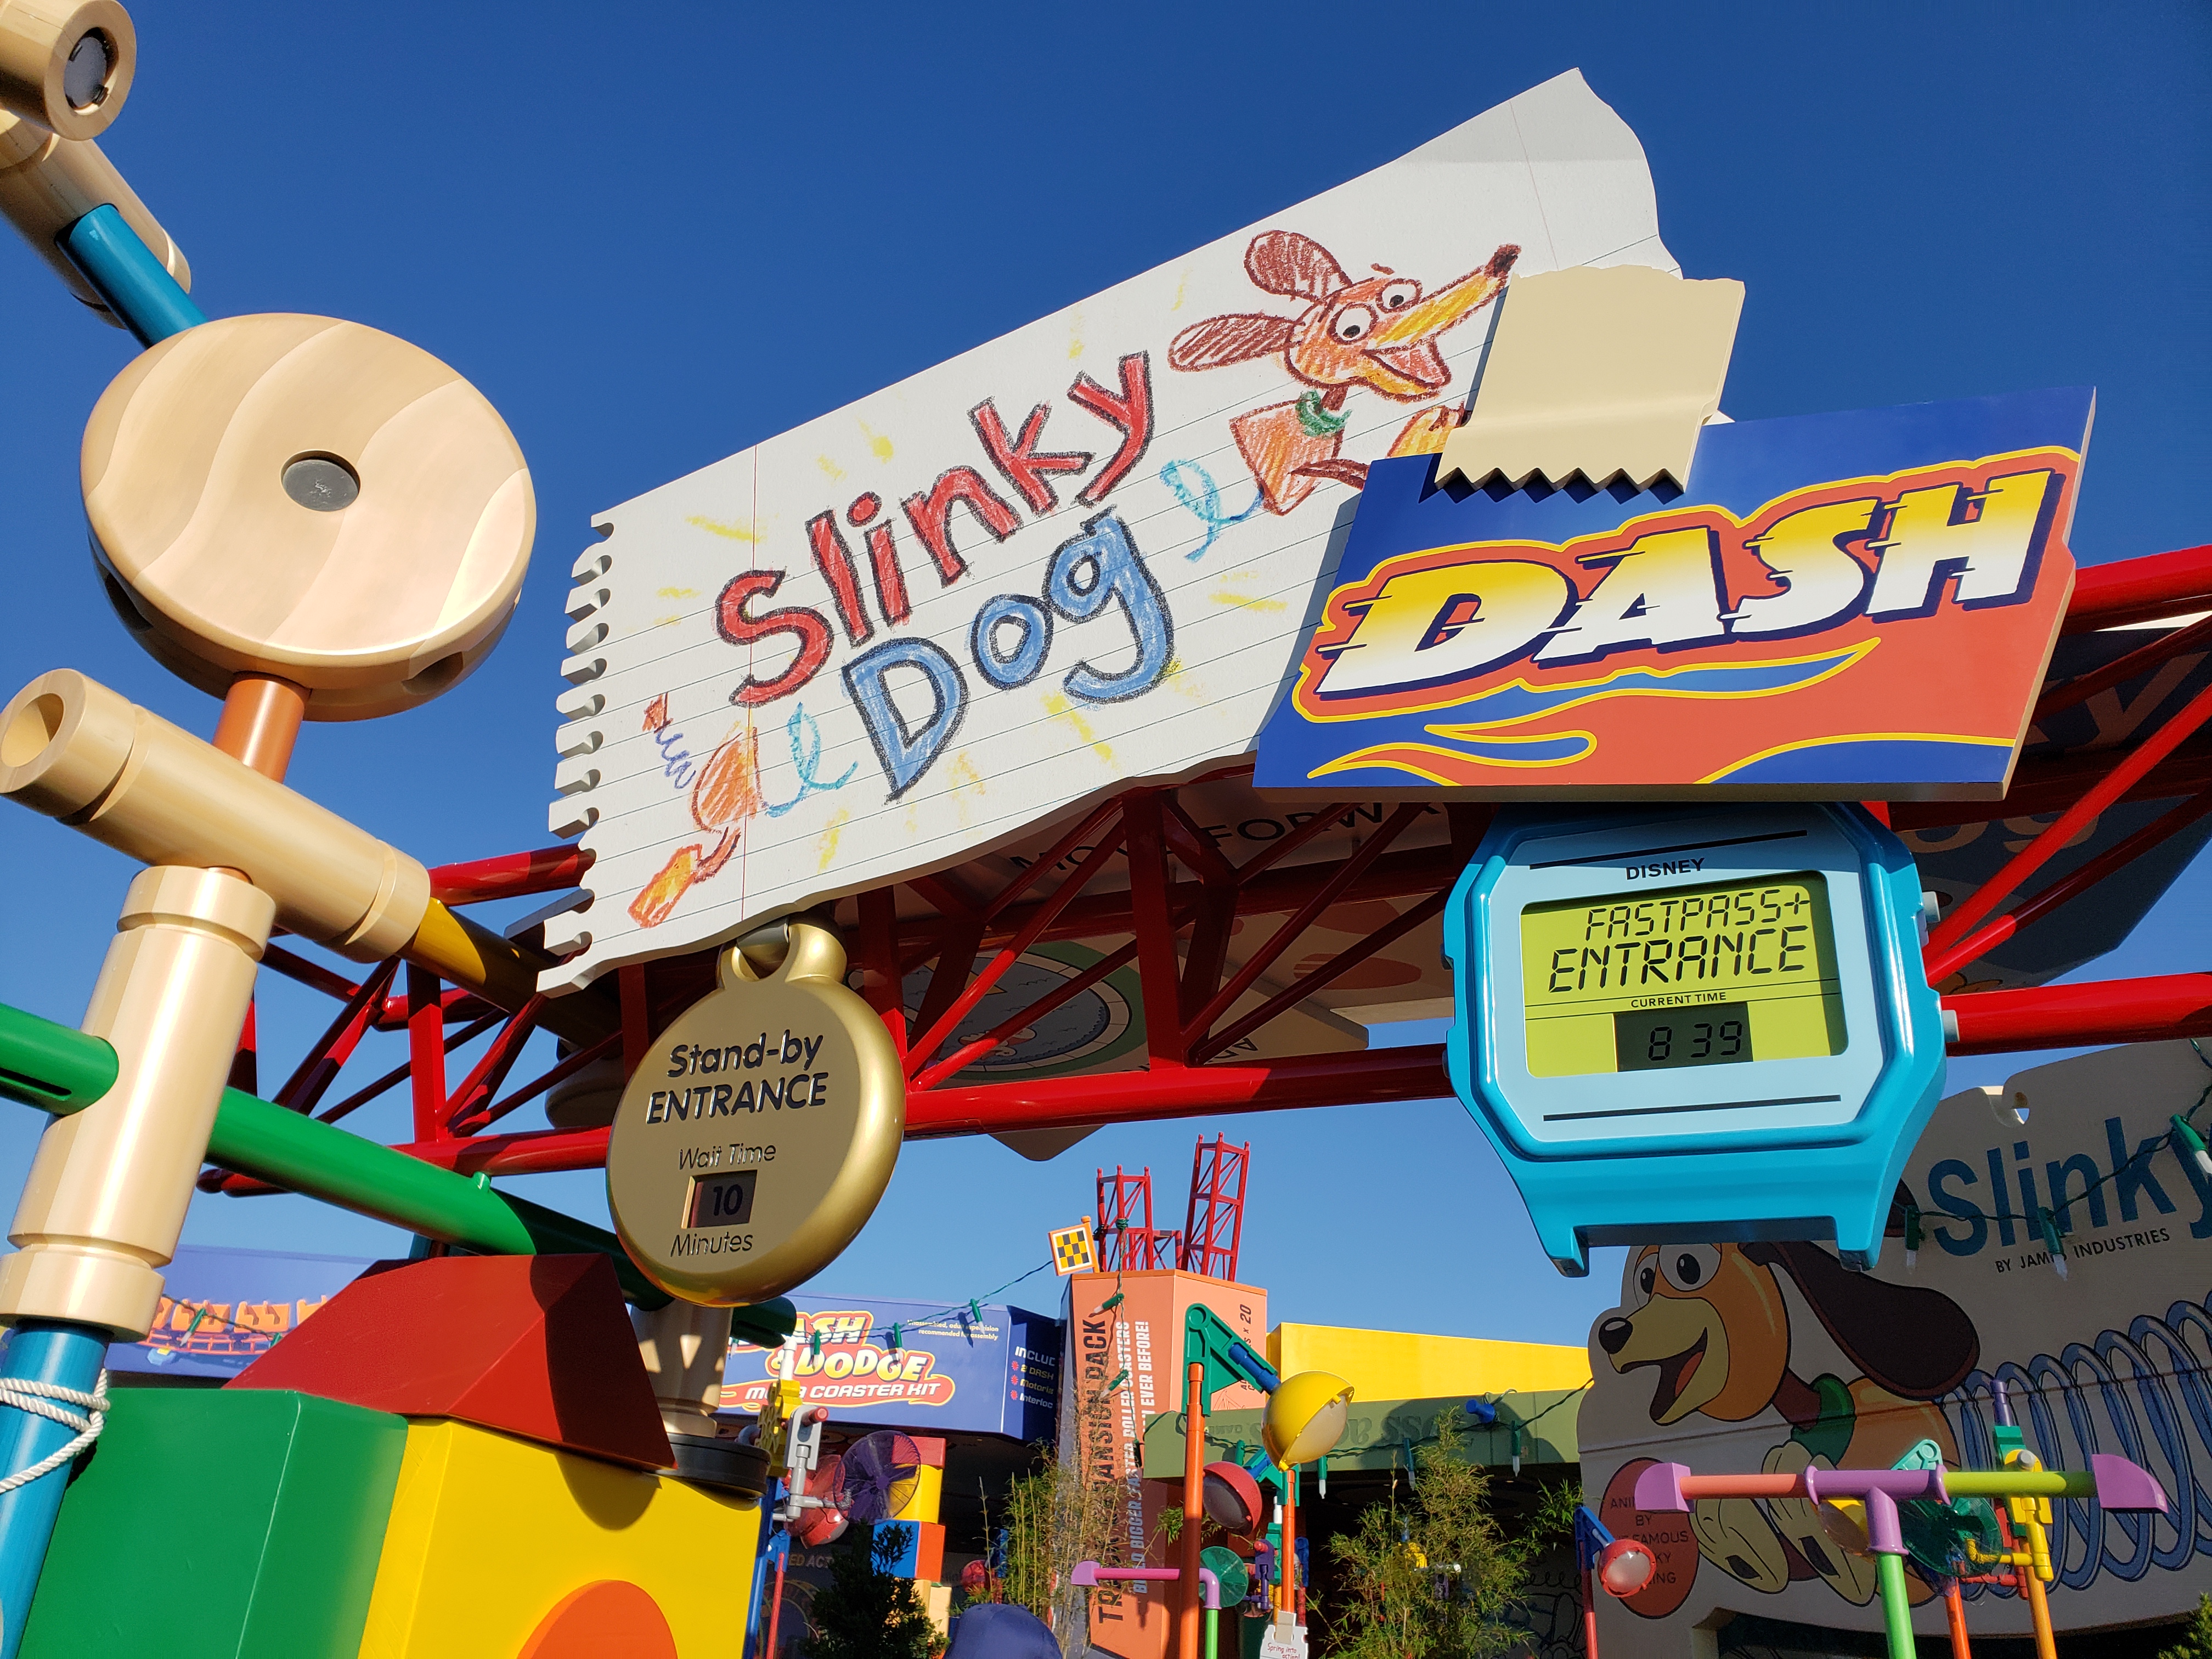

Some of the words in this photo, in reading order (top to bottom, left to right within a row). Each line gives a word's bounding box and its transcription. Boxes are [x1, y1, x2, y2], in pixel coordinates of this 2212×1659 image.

[714, 349, 1155, 708] Slinky
[1314, 469, 2063, 701] DASH
[840, 505, 1175, 805] Dog
[1626, 857, 1705, 881] DISNEY
[1585, 889, 1810, 941] FASTPASS+
[1548, 925, 1809, 993] ENTRANCE
[1631, 994, 1691, 1008] CURRENT
[1695, 991, 1727, 1003] TIME
[667, 1029, 823, 1078] Stand-by
[646, 1071, 829, 1124] ENTRANCE
[679, 1146, 722, 1170] Wait
[729, 1142, 776, 1165] Time
[713, 1183, 744, 1216] 10
[670, 1231, 753, 1257] Minutes
[1995, 1259, 2011, 1273] BY
[2073, 1227, 2170, 1259] INDUSTRIES
[1240, 1304, 1251, 1324] 20
[970, 1333, 998, 1341] assembly
[1082, 1319, 1109, 1380] PACK
[1135, 1321, 1152, 1372] BEFORE!
[793, 1347, 928, 1383] DODGE
[1020, 1364, 1028, 1373] 2
[1029, 1367, 1054, 1380] DASH
[809, 1383, 905, 1399] COASTER
[906, 1383, 941, 1397] KIT
[1139, 1374, 1155, 1406] EVER
[1120, 1389, 1135, 1437] ROLLER
[1635, 1515, 1652, 1526] BY
[1267, 1642, 1284, 1654] Spring
